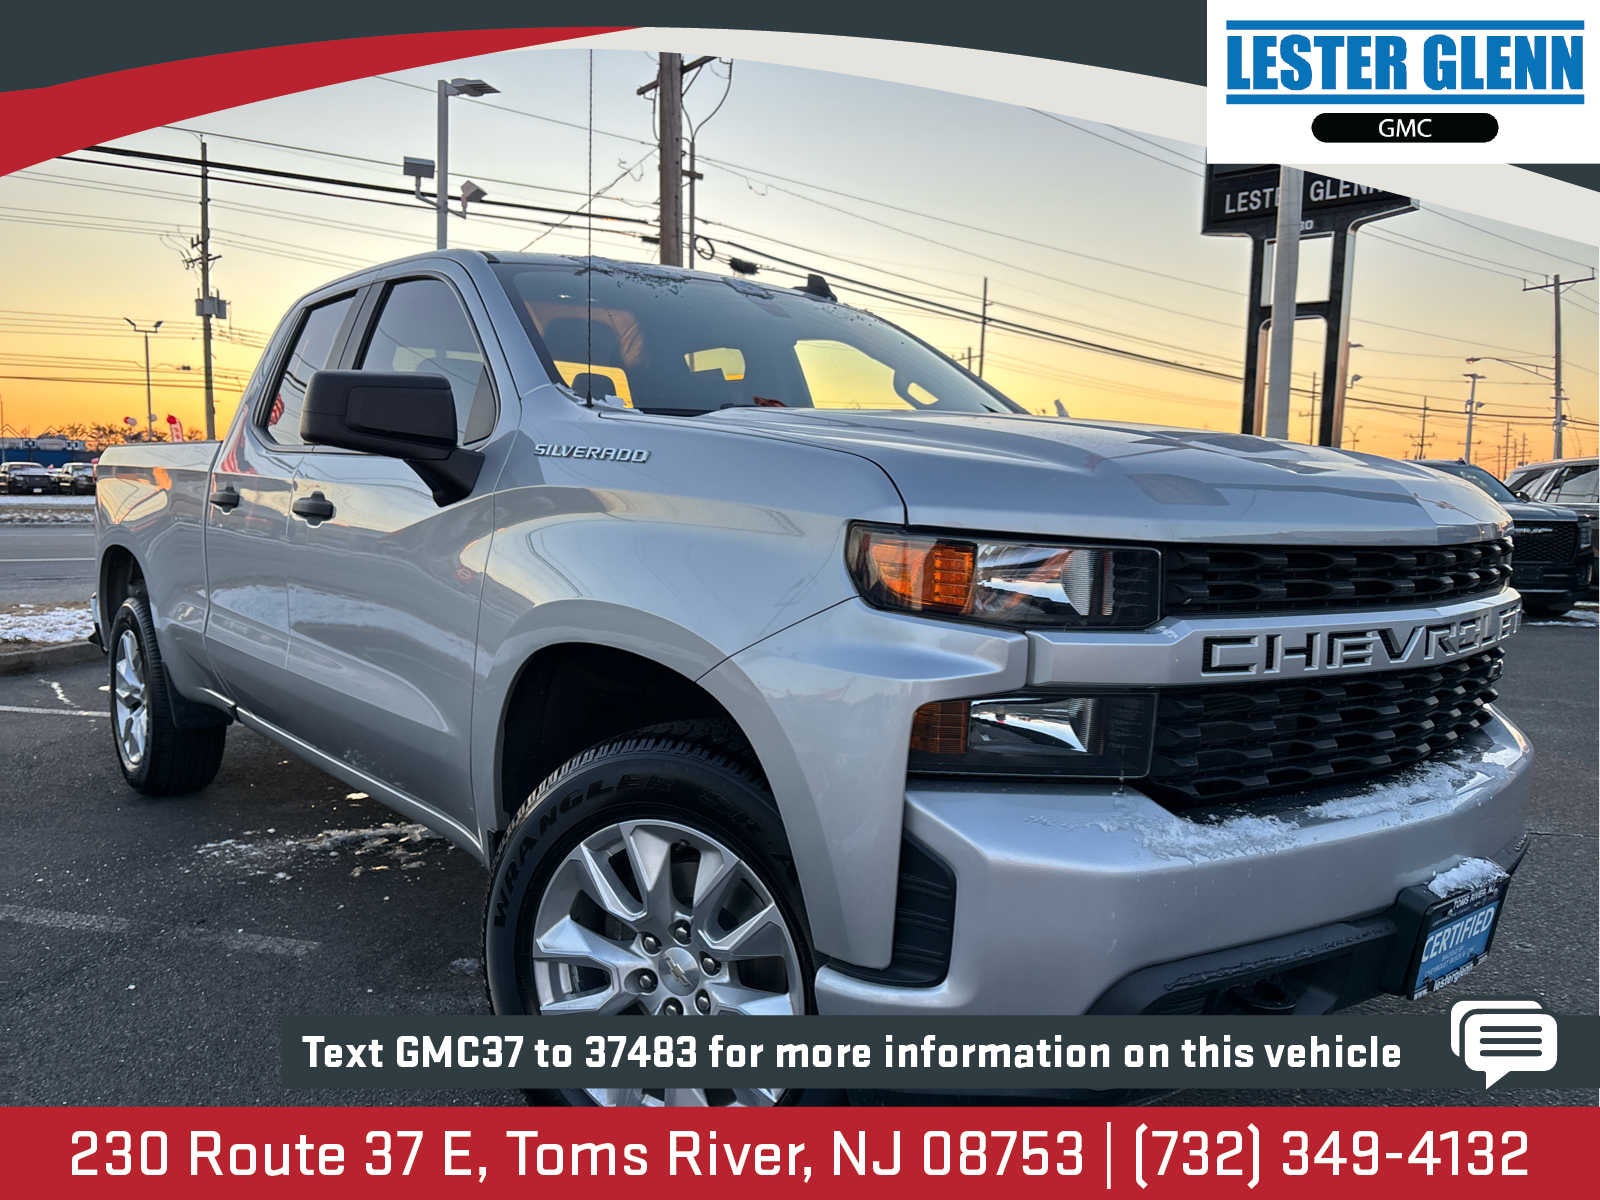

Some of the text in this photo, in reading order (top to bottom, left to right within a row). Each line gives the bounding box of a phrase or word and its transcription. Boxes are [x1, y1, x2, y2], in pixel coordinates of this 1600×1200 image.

[1225, 187, 1280, 214] LEST
[534, 443, 651, 464] SILVERADO
[1421, 906, 1495, 963] CERTIFIED
